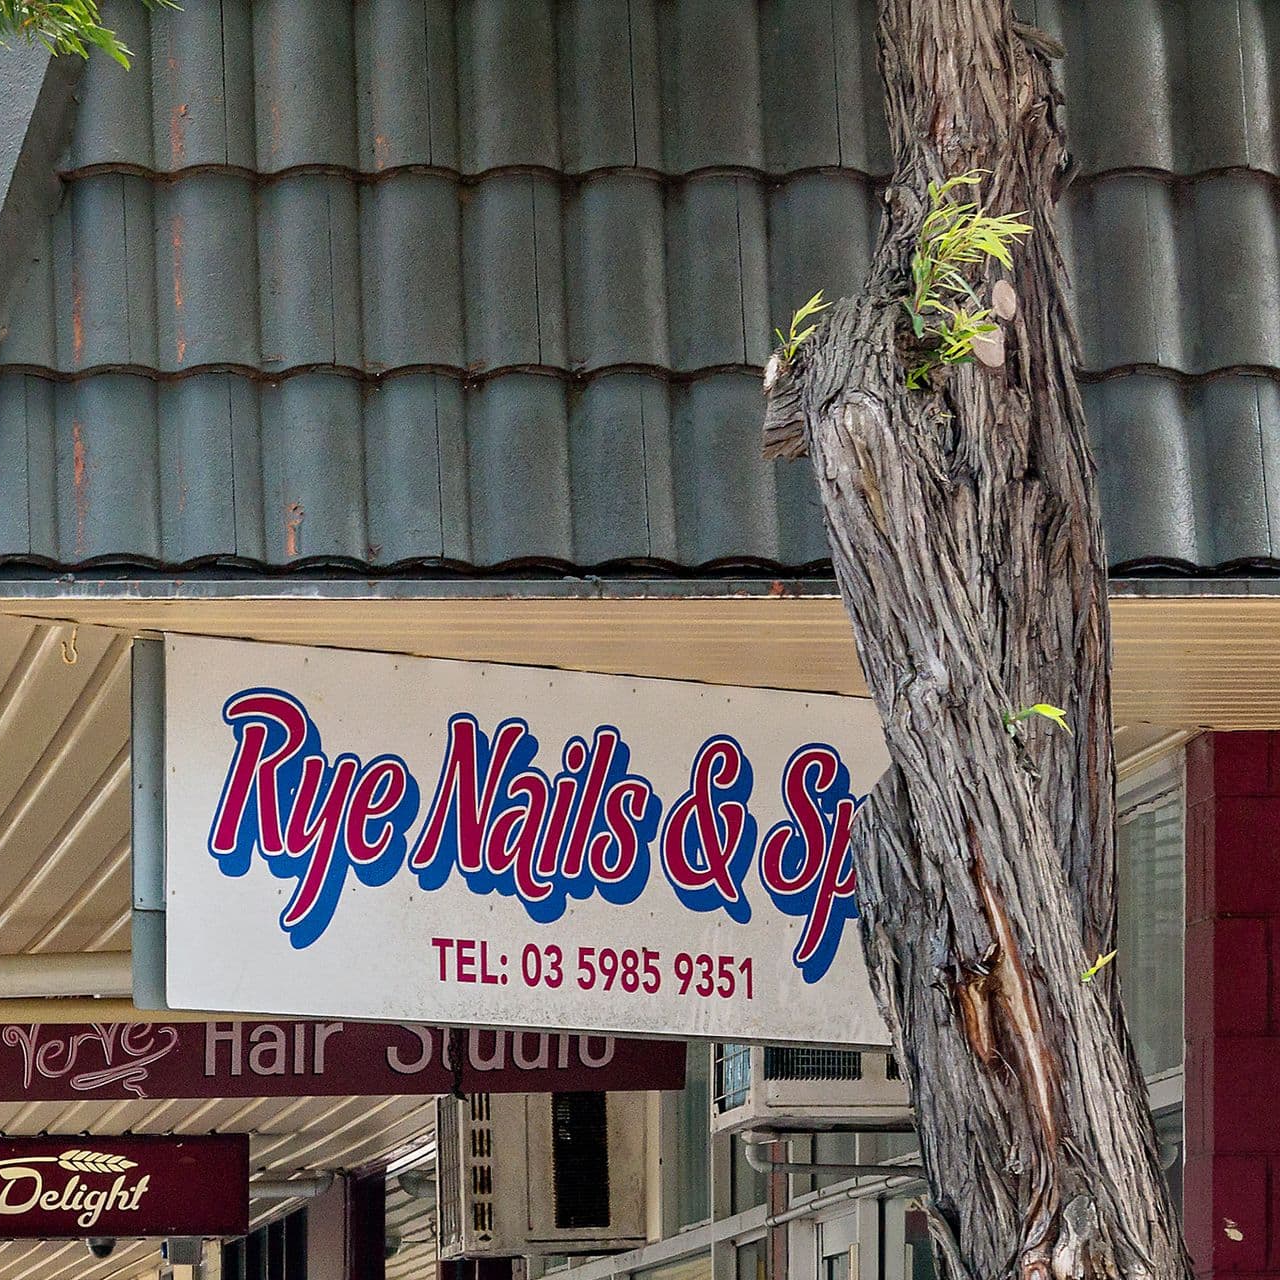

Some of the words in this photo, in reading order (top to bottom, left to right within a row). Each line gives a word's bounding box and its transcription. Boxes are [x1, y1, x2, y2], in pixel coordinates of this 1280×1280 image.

[209, 687, 421, 948] Rye
[411, 712, 661, 923] Nails
[661, 734, 753, 924] &
[432, 937, 508, 985] TEL:
[522, 943, 563, 989] 03
[577, 947, 661, 994] 5985
[674, 952, 753, 1000] 9351
[205, 1022, 344, 1076] Hair
